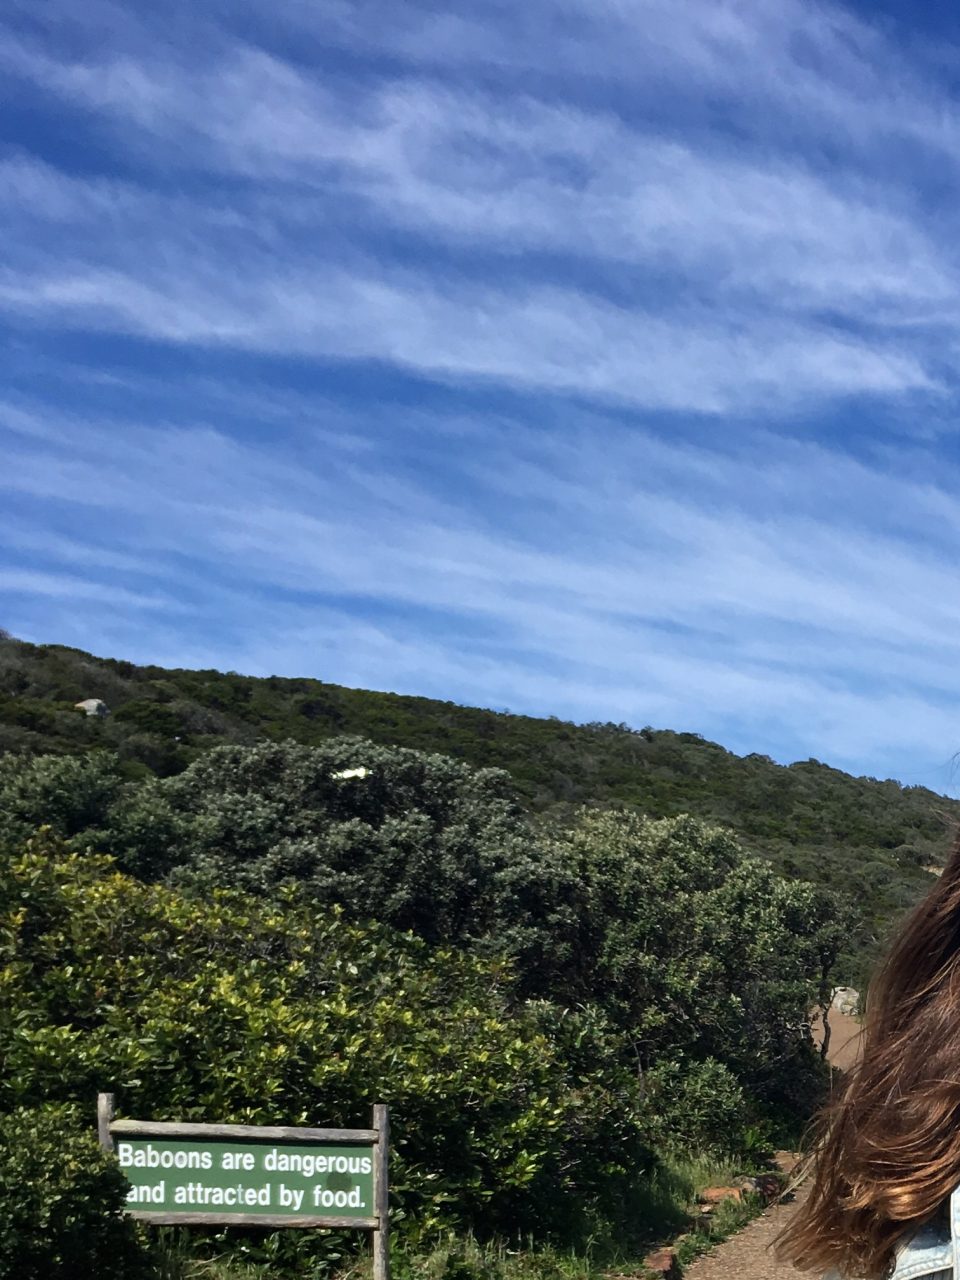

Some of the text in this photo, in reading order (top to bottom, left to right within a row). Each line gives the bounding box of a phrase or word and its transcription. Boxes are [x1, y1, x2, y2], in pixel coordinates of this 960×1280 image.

[118, 1143, 372, 1177] Baboons are dangerous
[125, 1180, 366, 1212] and attracted by food.
